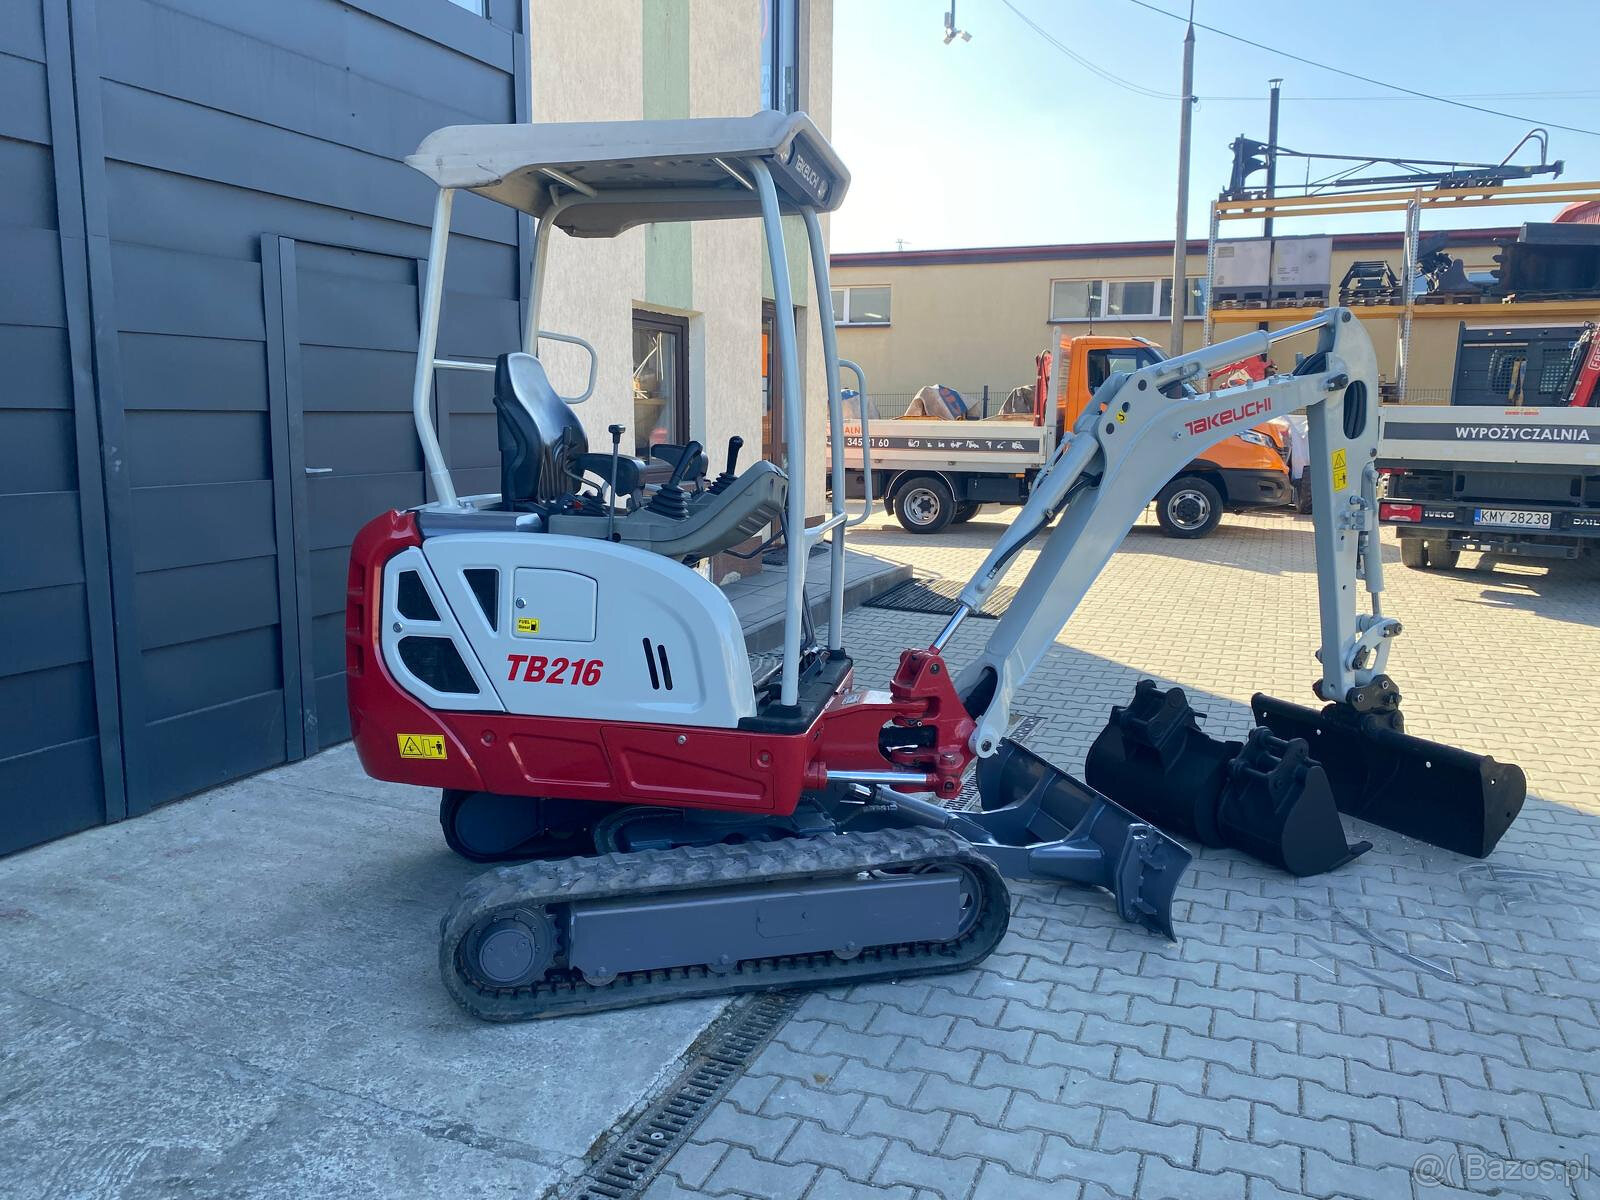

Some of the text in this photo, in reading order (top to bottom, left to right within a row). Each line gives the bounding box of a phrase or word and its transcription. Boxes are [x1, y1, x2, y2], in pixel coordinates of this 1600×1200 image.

[1185, 397, 1272, 436] TAKEUCHI
[1455, 425, 1590, 441] WYPOŻYCZALNIA
[847, 438, 863, 447] 345
[878, 438, 889, 447] 60
[1424, 511, 1455, 519] IVECO
[1481, 510, 1549, 525] KMY 28238
[507, 654, 604, 687] TB216
